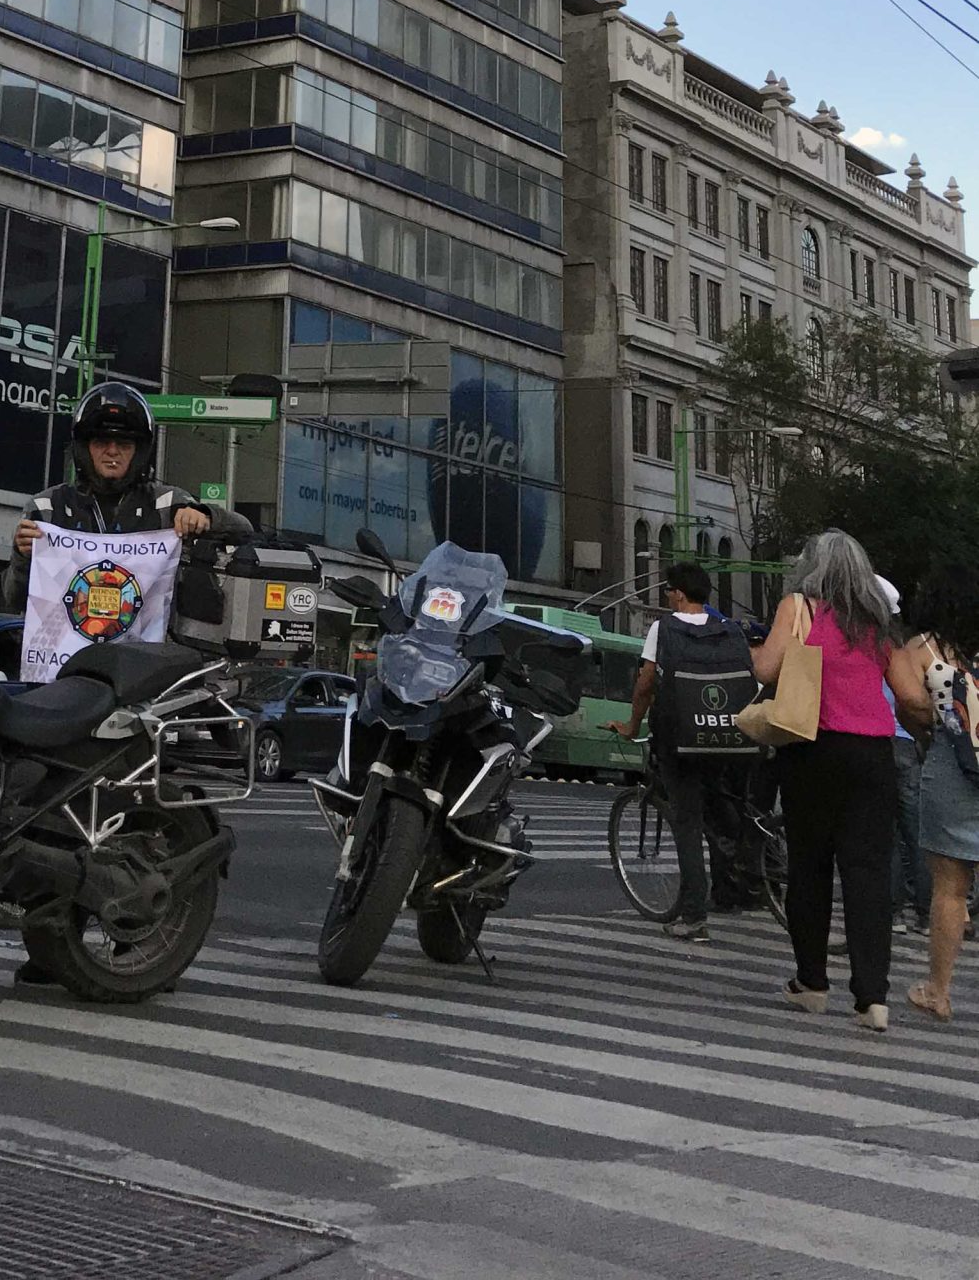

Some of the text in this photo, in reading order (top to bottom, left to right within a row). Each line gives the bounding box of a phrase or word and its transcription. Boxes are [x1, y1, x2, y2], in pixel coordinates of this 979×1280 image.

[450, 420, 526, 480] telce
[298, 484, 319, 501] con
[370, 496, 418, 522] Cobertua
[47, 532, 168, 556] MOTO TURISTA
[292, 594, 312, 605] YRC
[27, 649, 46, 664] EN
[696, 732, 743, 745] EATS
